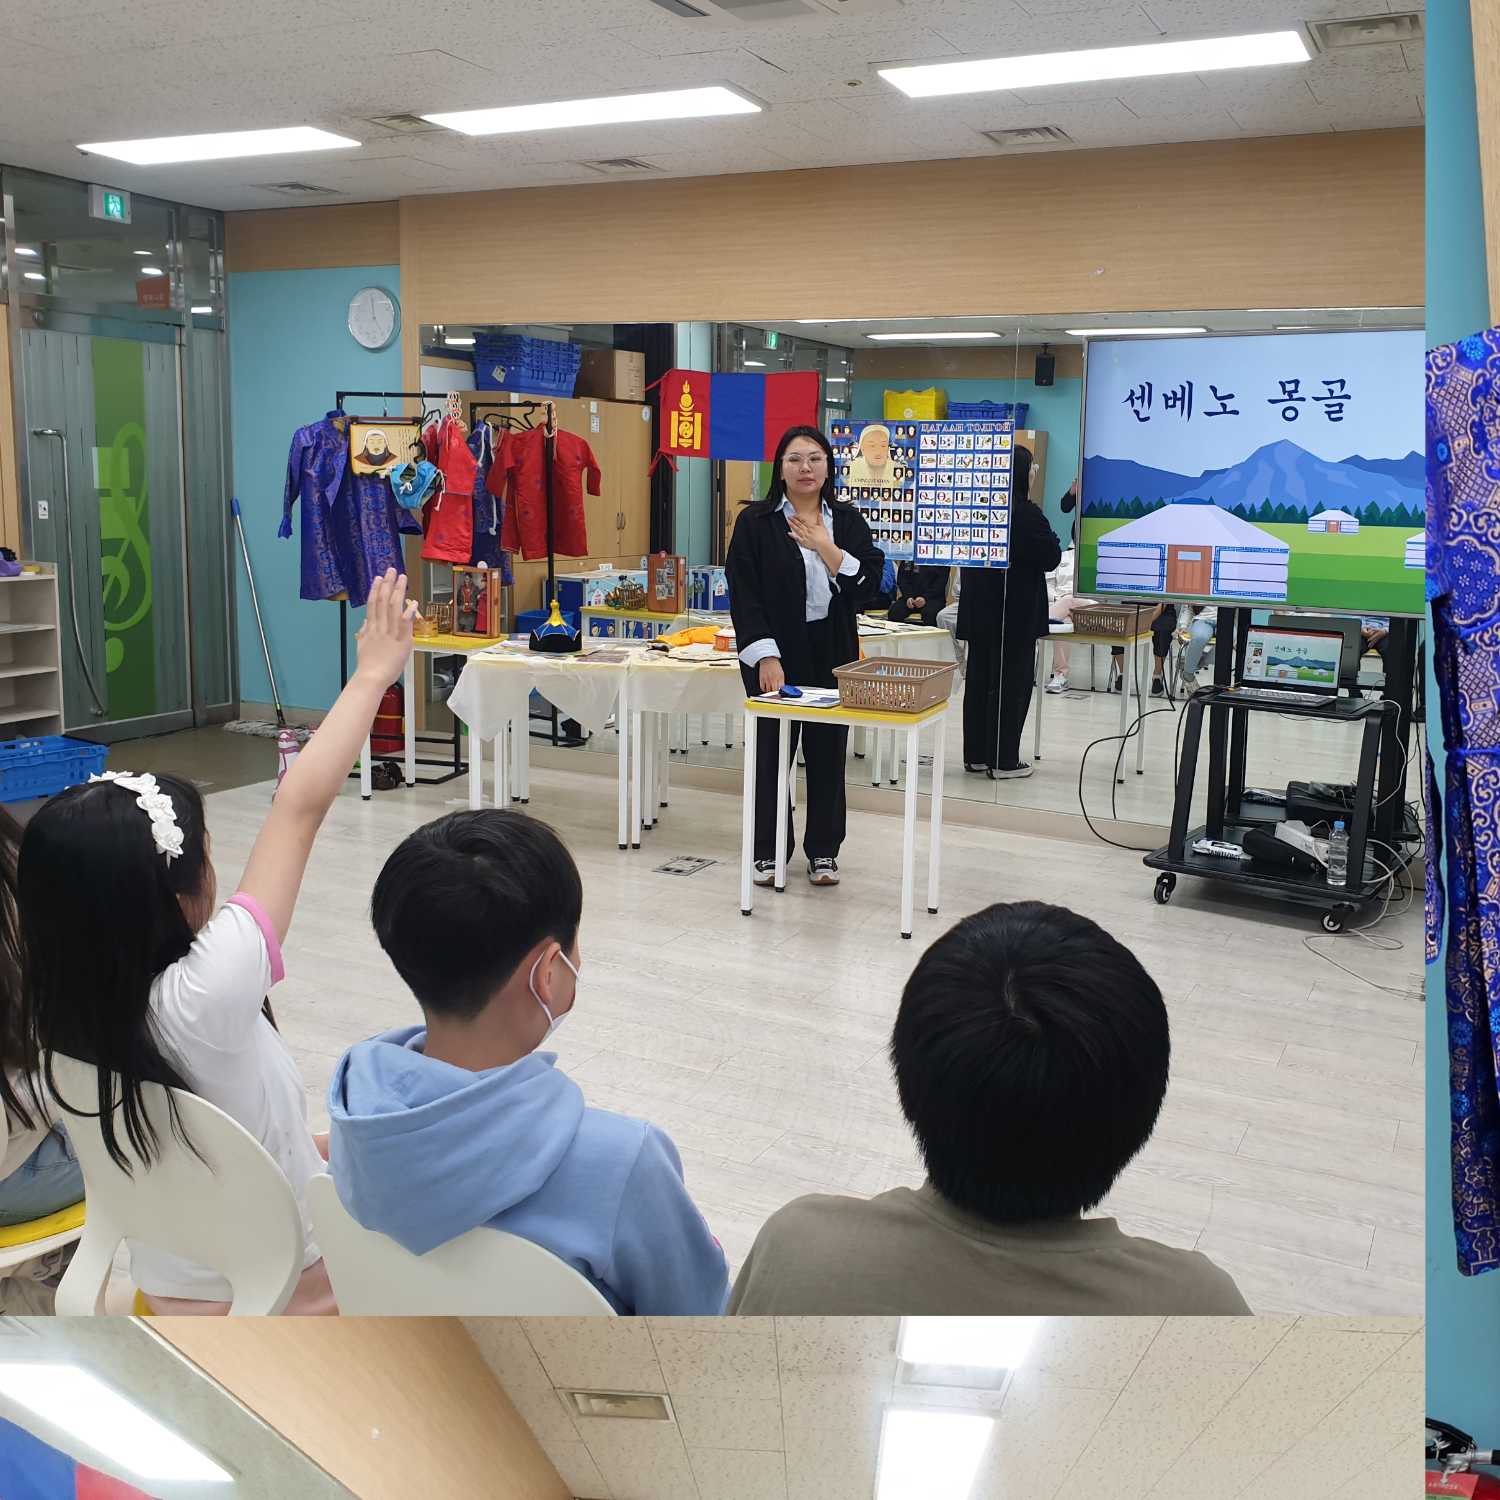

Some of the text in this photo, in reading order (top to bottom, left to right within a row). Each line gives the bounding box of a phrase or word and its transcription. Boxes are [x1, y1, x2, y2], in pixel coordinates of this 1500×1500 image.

[1121, 378, 1352, 422] 센베노 몽골
[921, 422, 1011, 433] ЦАГААН ТОЛГОЙ
